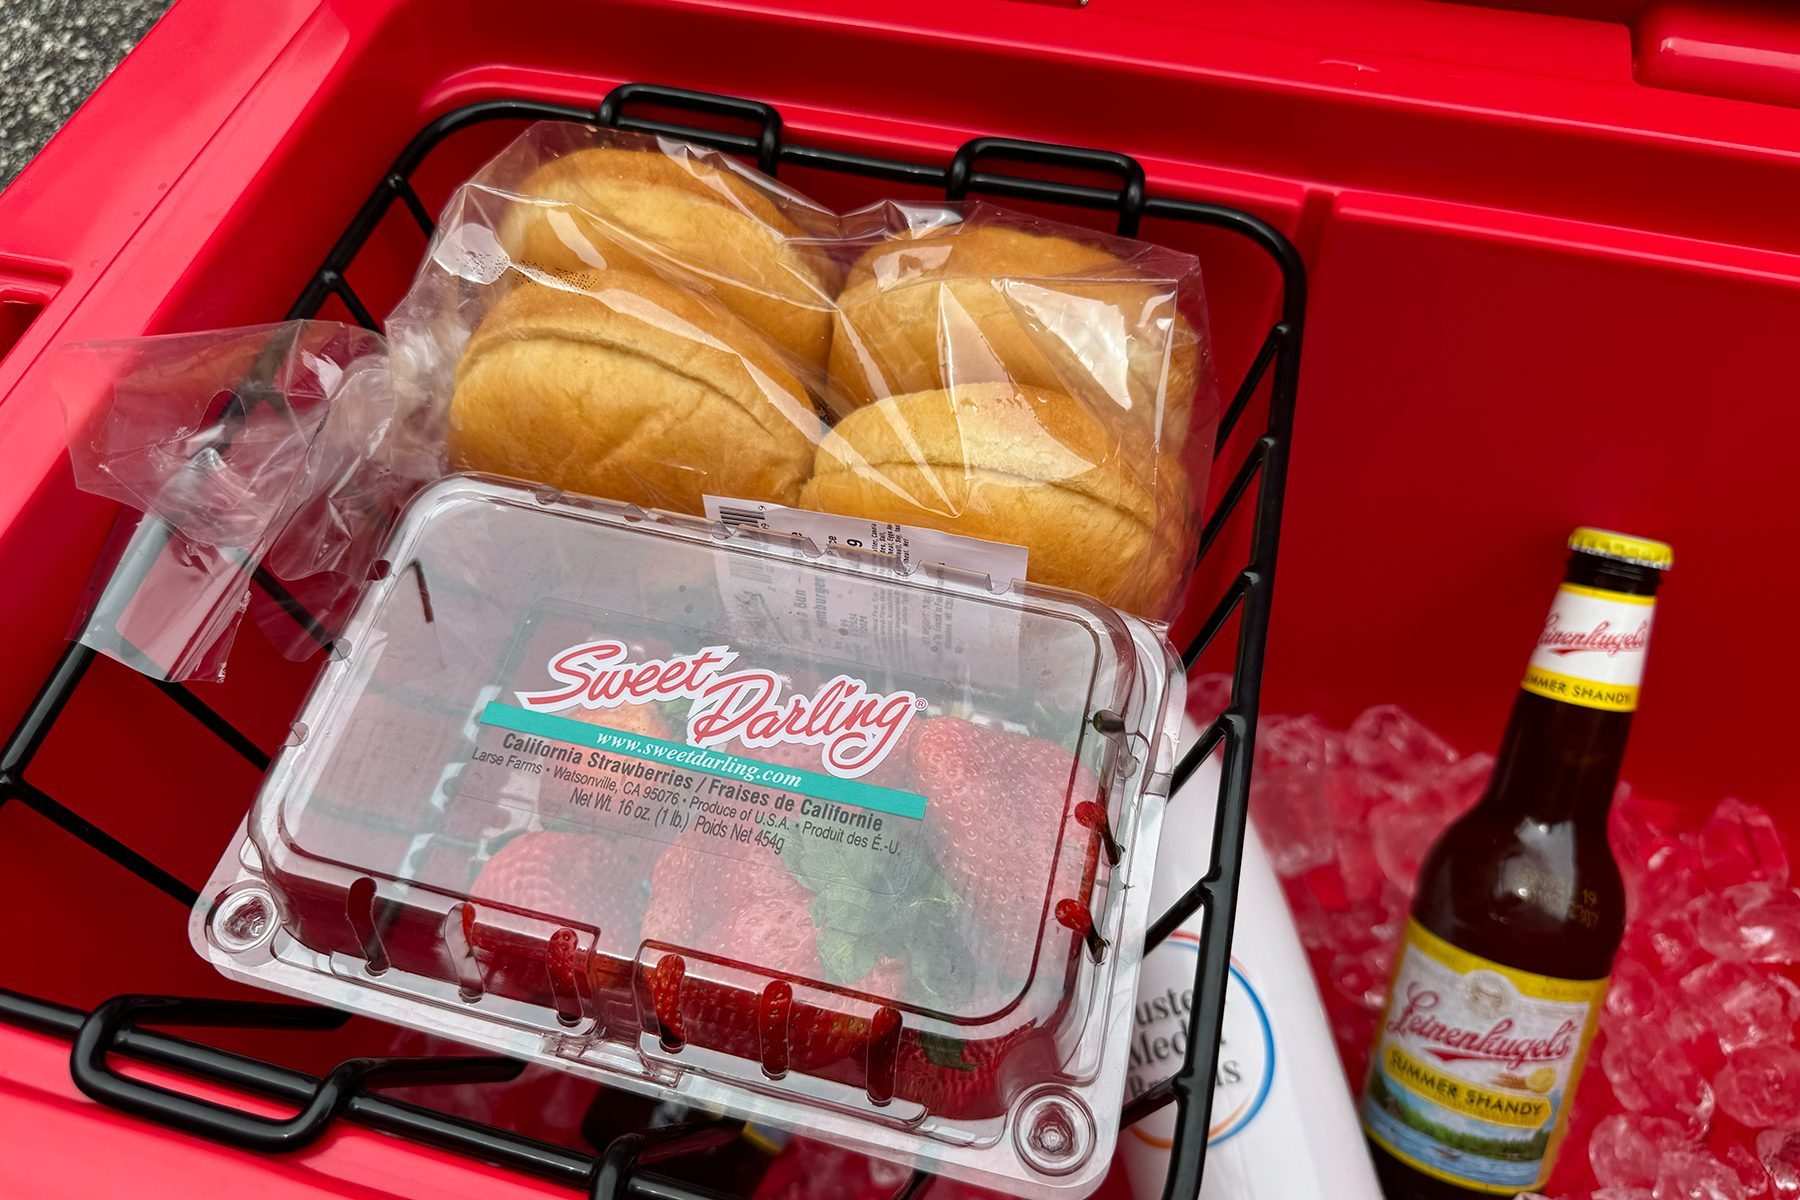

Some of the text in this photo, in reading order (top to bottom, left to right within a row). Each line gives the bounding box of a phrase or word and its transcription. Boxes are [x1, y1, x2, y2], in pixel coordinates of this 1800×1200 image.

[526, 644, 724, 705] Sweet
[1526, 673, 1631, 705] UMMER SHANDY
[693, 673, 912, 770] Darling
[503, 732, 583, 765] California
[588, 752, 693, 789] Strawberries
[708, 778, 770, 806] Fraises
[774, 793, 795, 812] de
[800, 798, 883, 832] Californie
[596, 732, 803, 788] www.sweetdarling.com
[472, 747, 504, 766] Larse
[506, 754, 543, 775] Farms
[553, 765, 618, 794] Watsonville,
[623, 781, 641, 797] CA
[642, 785, 680, 806] 95076
[689, 796, 737, 818] Produce
[739, 808, 754, 821] of
[754, 810, 790, 831] U.S.A.
[802, 821, 845, 843] Produit
[846, 830, 868, 848] des
[569, 786, 785, 855] Net Wt. 16 oz. (1 lb.) Poids Net 454g
[1385, 980, 1579, 1070] Leinenkugel's
[1390, 1051, 1543, 1117] SUMMER SHANDY
